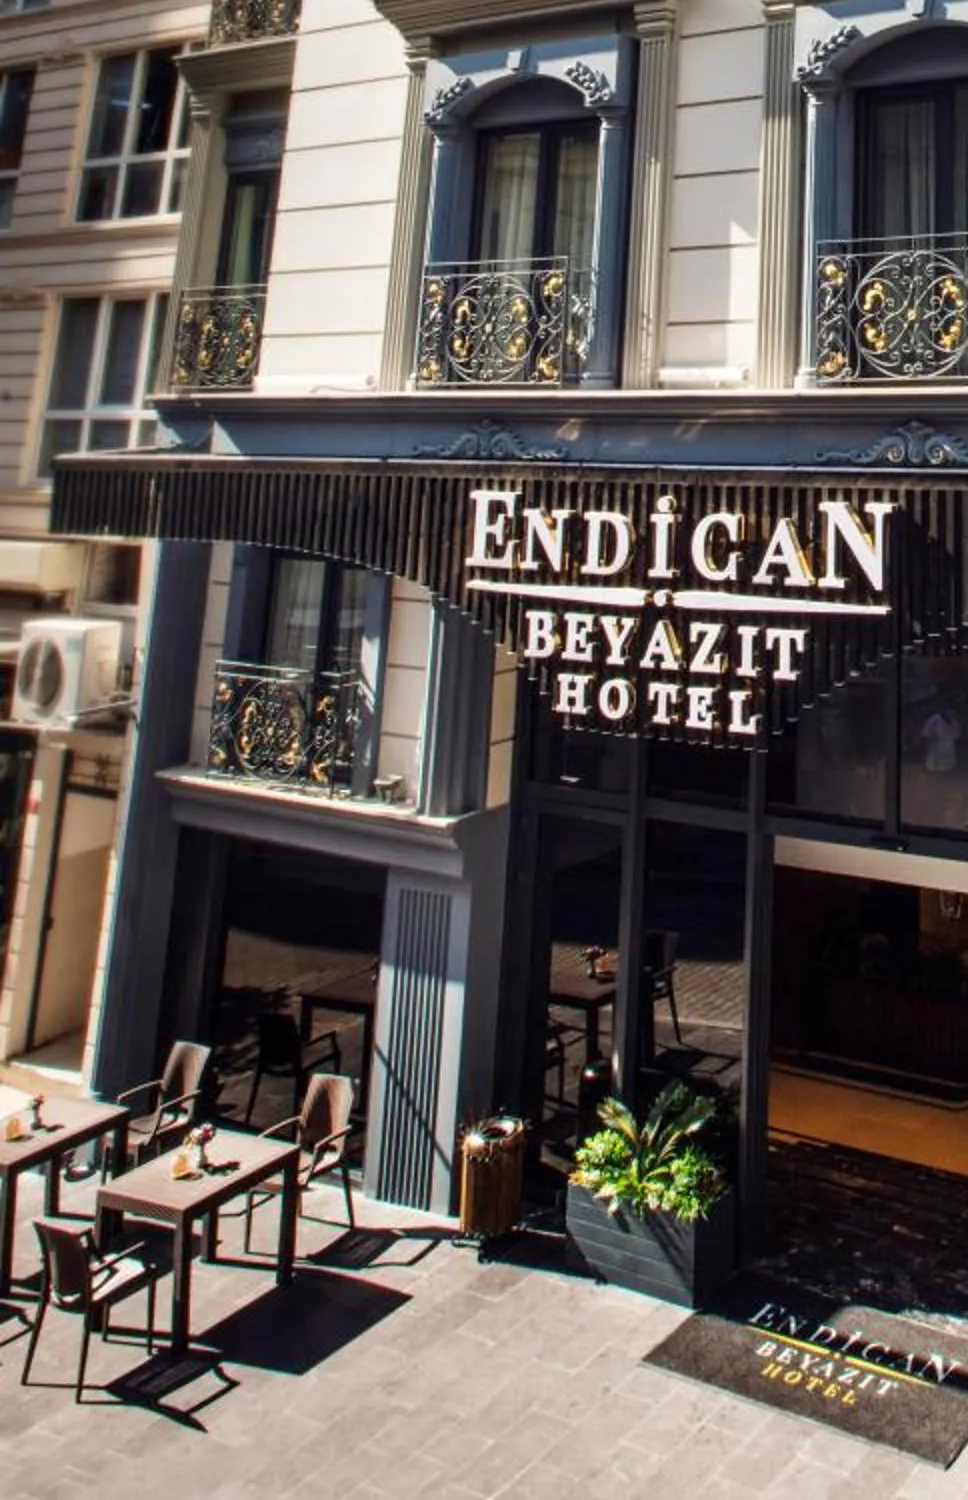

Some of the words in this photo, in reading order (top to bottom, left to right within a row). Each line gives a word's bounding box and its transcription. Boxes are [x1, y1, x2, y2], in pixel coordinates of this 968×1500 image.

[523, 610, 810, 681] BEYAZIT
[552, 673, 763, 735] HOTEL
[754, 1340, 900, 1397] BEYAZIT
[760, 1362, 857, 1406] HOTEL
